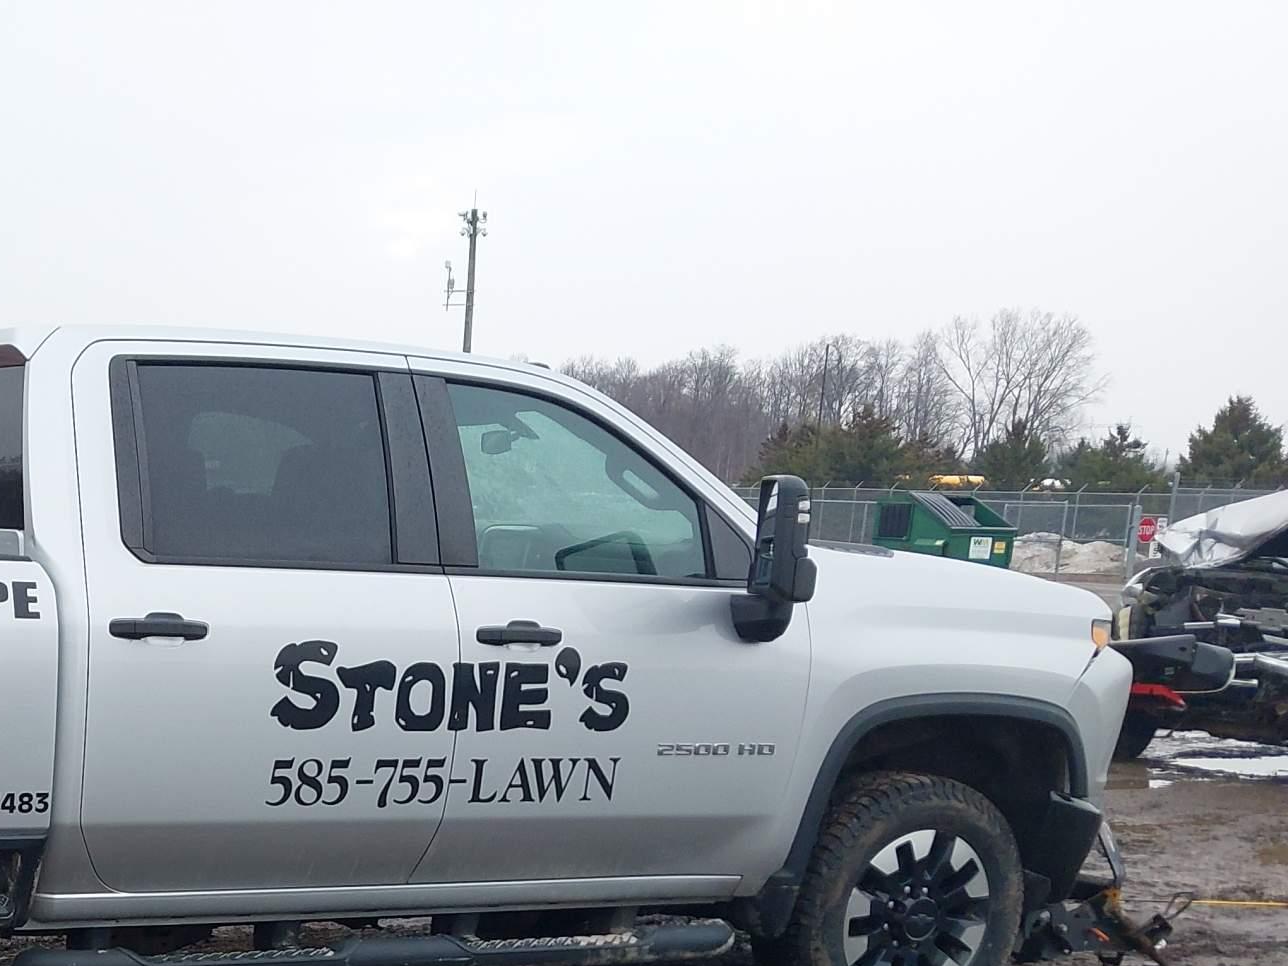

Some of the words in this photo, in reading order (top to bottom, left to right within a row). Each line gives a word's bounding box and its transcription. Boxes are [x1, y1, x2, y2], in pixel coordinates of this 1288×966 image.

[1137, 524, 1155, 535] STOP
[657, 742, 730, 756] 2500
[737, 742, 776, 756] HD
[265, 756, 622, 808] 585-755-LAWN
